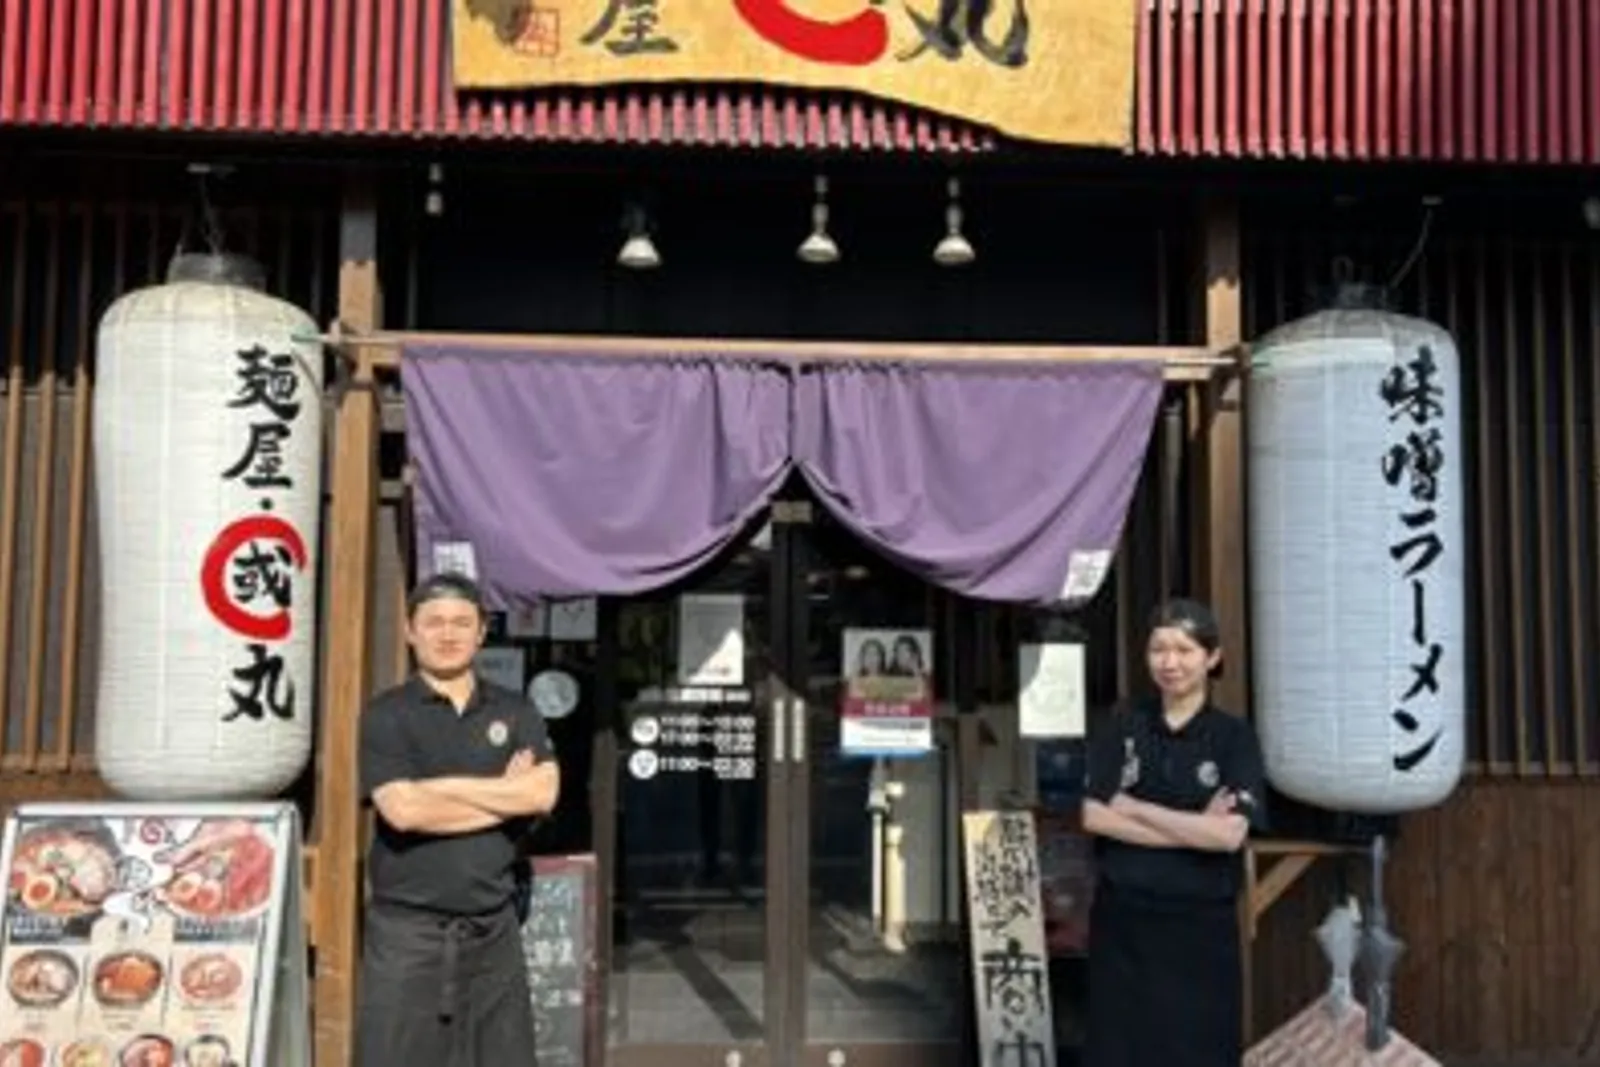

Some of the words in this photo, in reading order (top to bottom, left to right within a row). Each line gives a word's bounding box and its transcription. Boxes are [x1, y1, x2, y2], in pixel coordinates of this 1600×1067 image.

[1379, 344, 1444, 772] 味噌ラーメン
